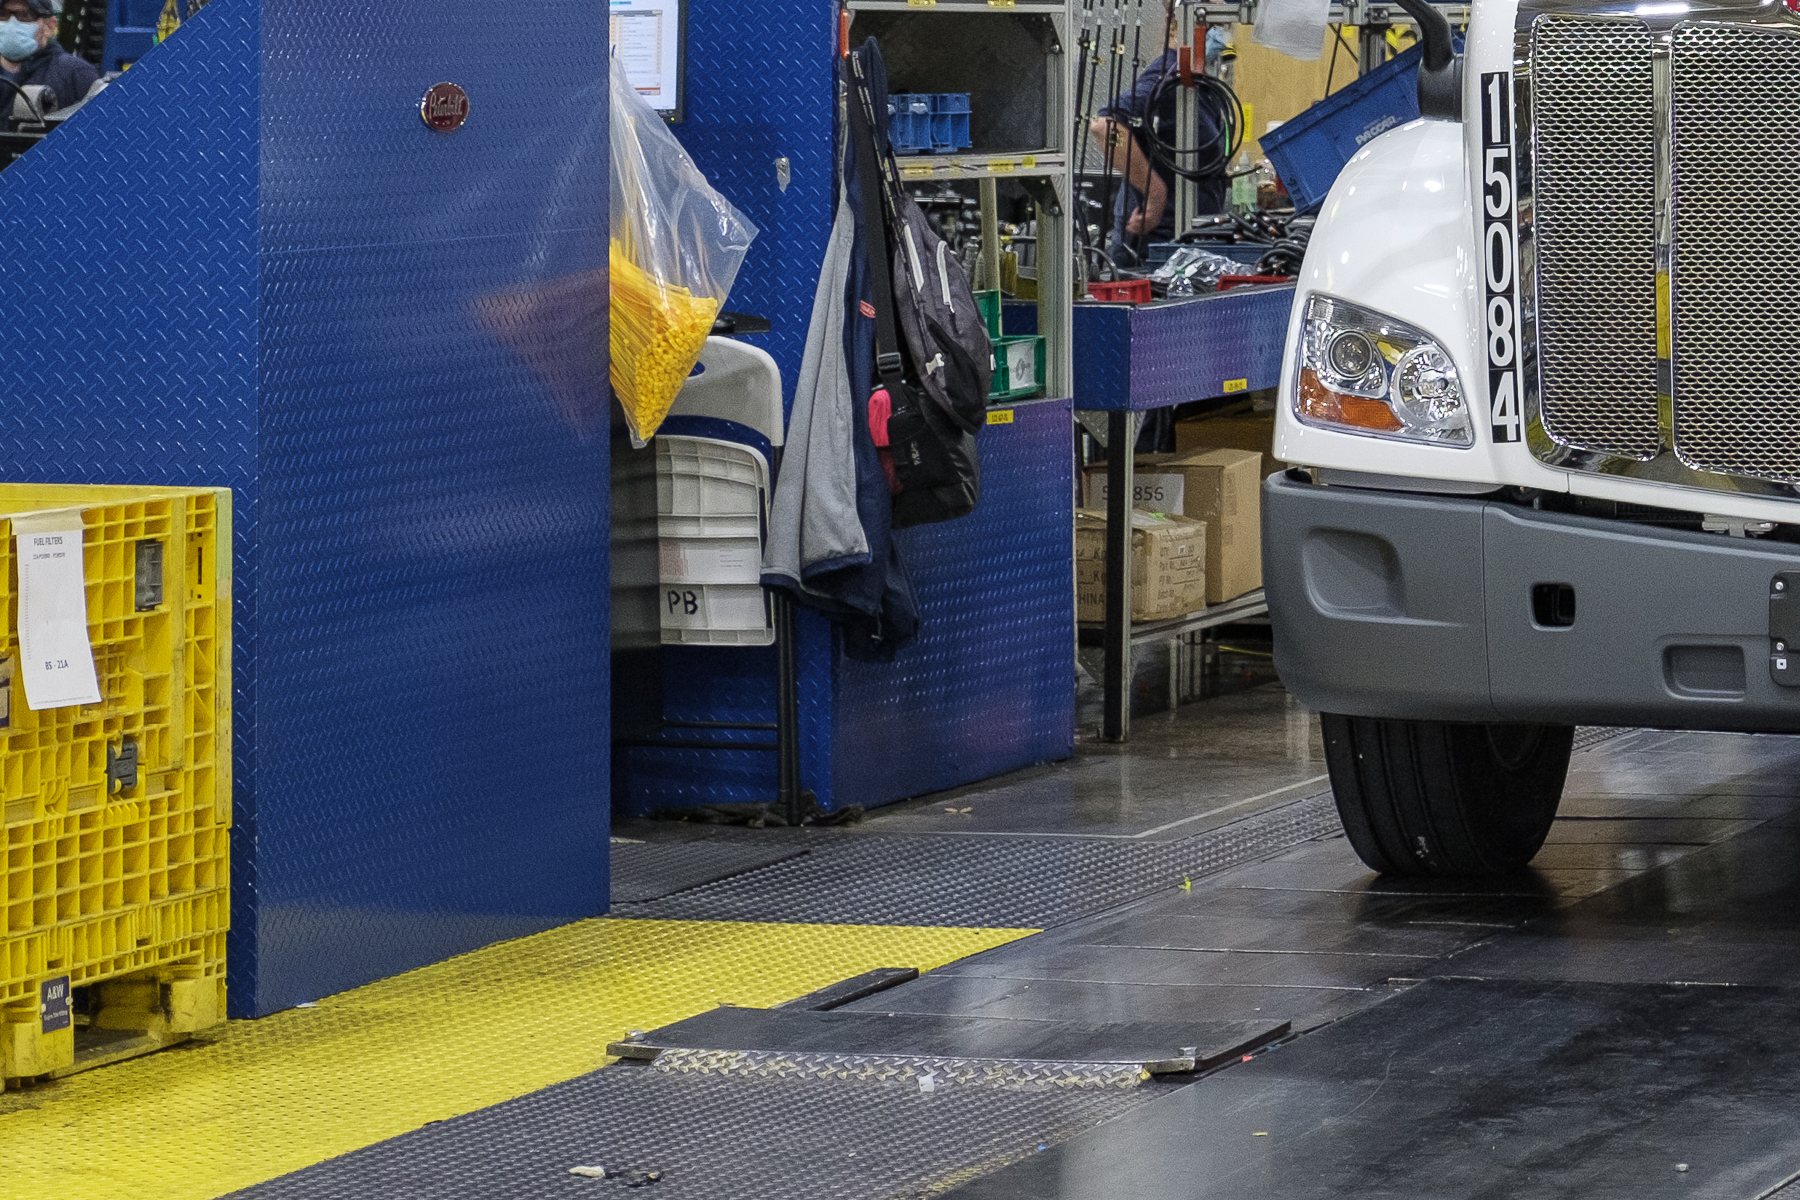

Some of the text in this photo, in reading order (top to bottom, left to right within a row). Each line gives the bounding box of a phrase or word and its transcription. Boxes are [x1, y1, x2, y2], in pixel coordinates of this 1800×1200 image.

[429, 91, 466, 120] Peterbilt
[1484, 73, 1519, 442] 15084
[33, 536, 63, 546] FUEL FILTERS
[667, 590, 698, 615] PB
